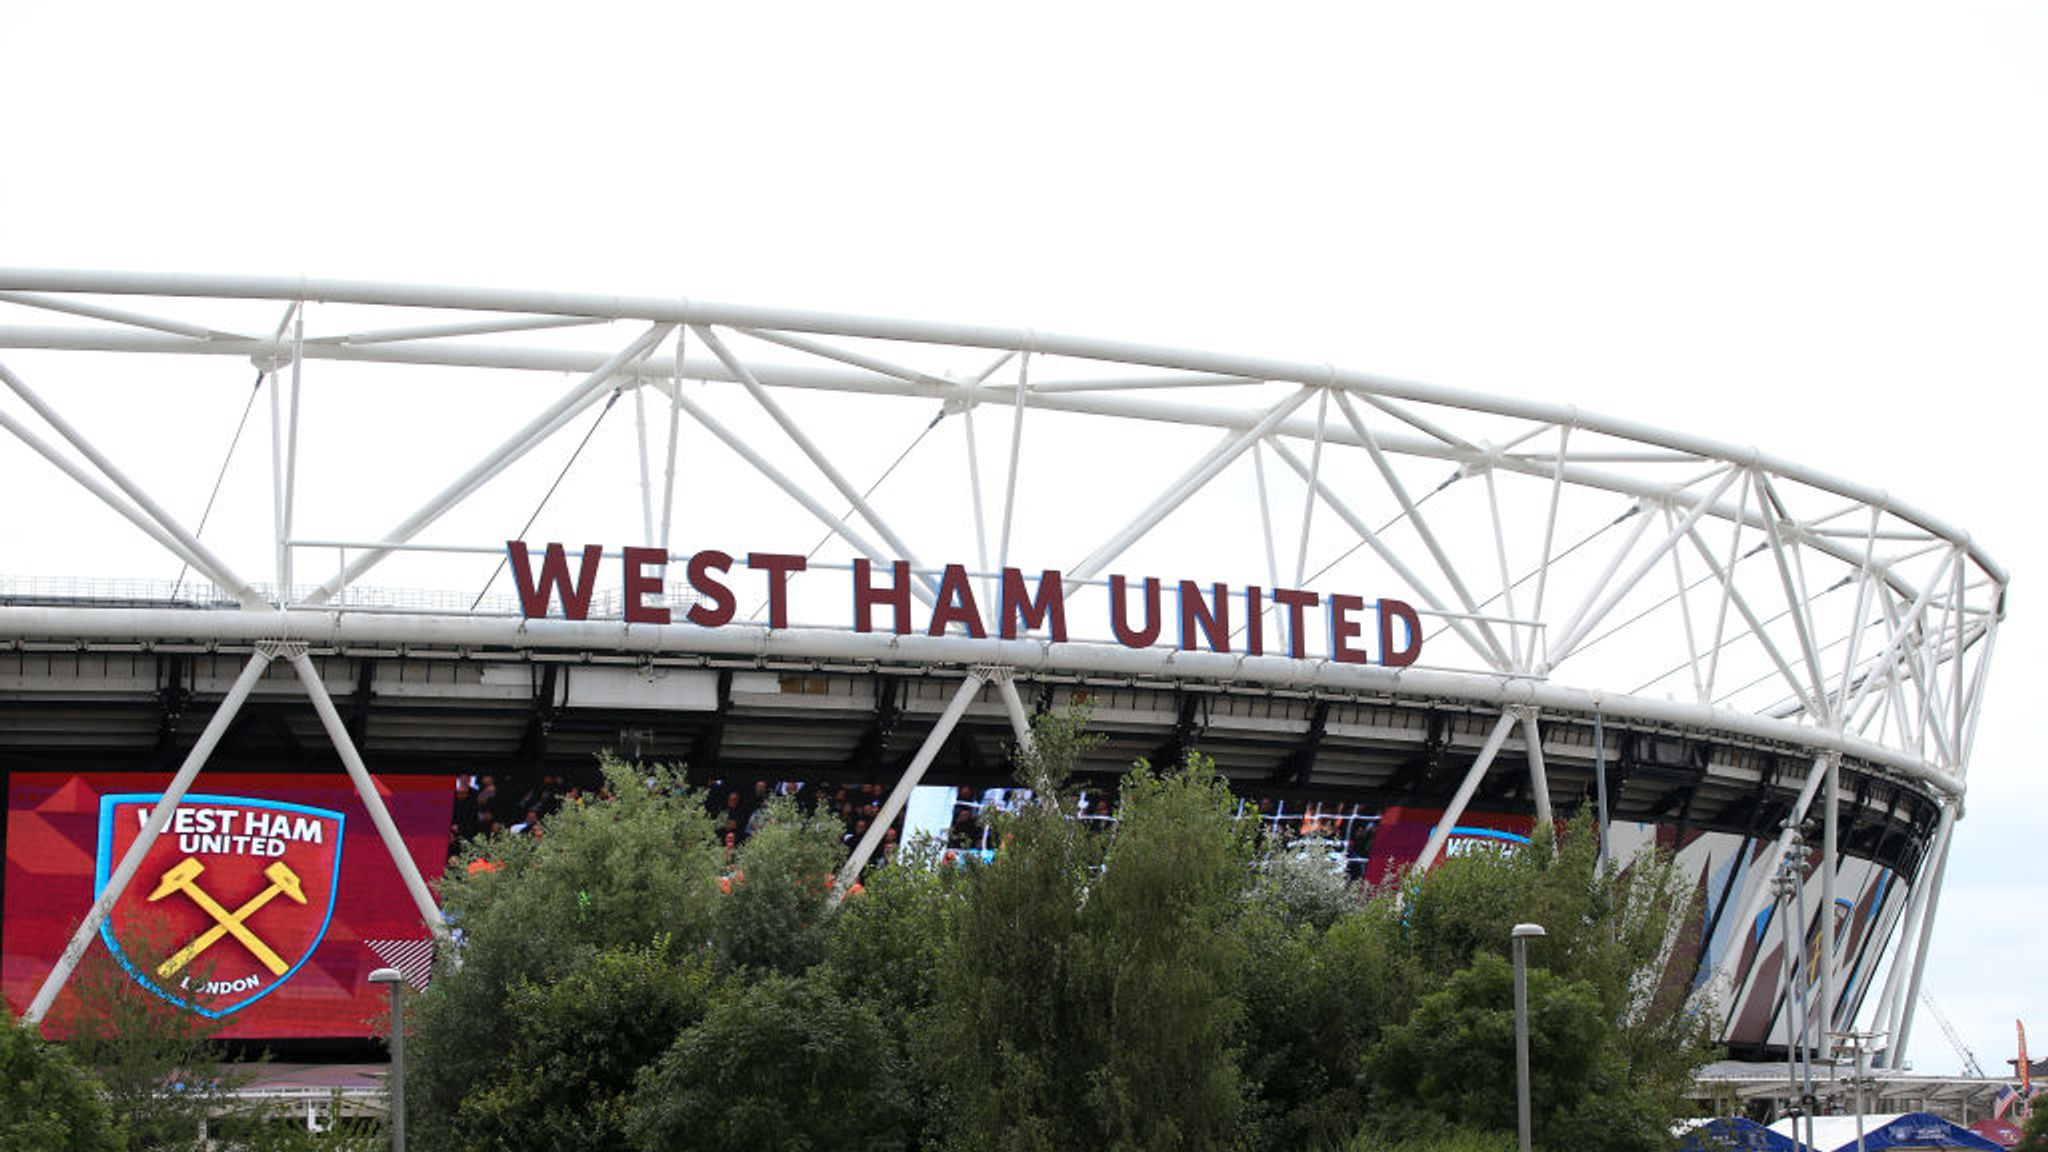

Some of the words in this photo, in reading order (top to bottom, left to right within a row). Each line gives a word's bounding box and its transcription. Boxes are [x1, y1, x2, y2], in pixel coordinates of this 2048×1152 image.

[506, 540, 807, 630] WEST
[852, 556, 1068, 644] HAM
[1108, 573, 1424, 667] UNITED
[244, 812, 323, 844] HAM
[179, 834, 286, 857] UNITED
